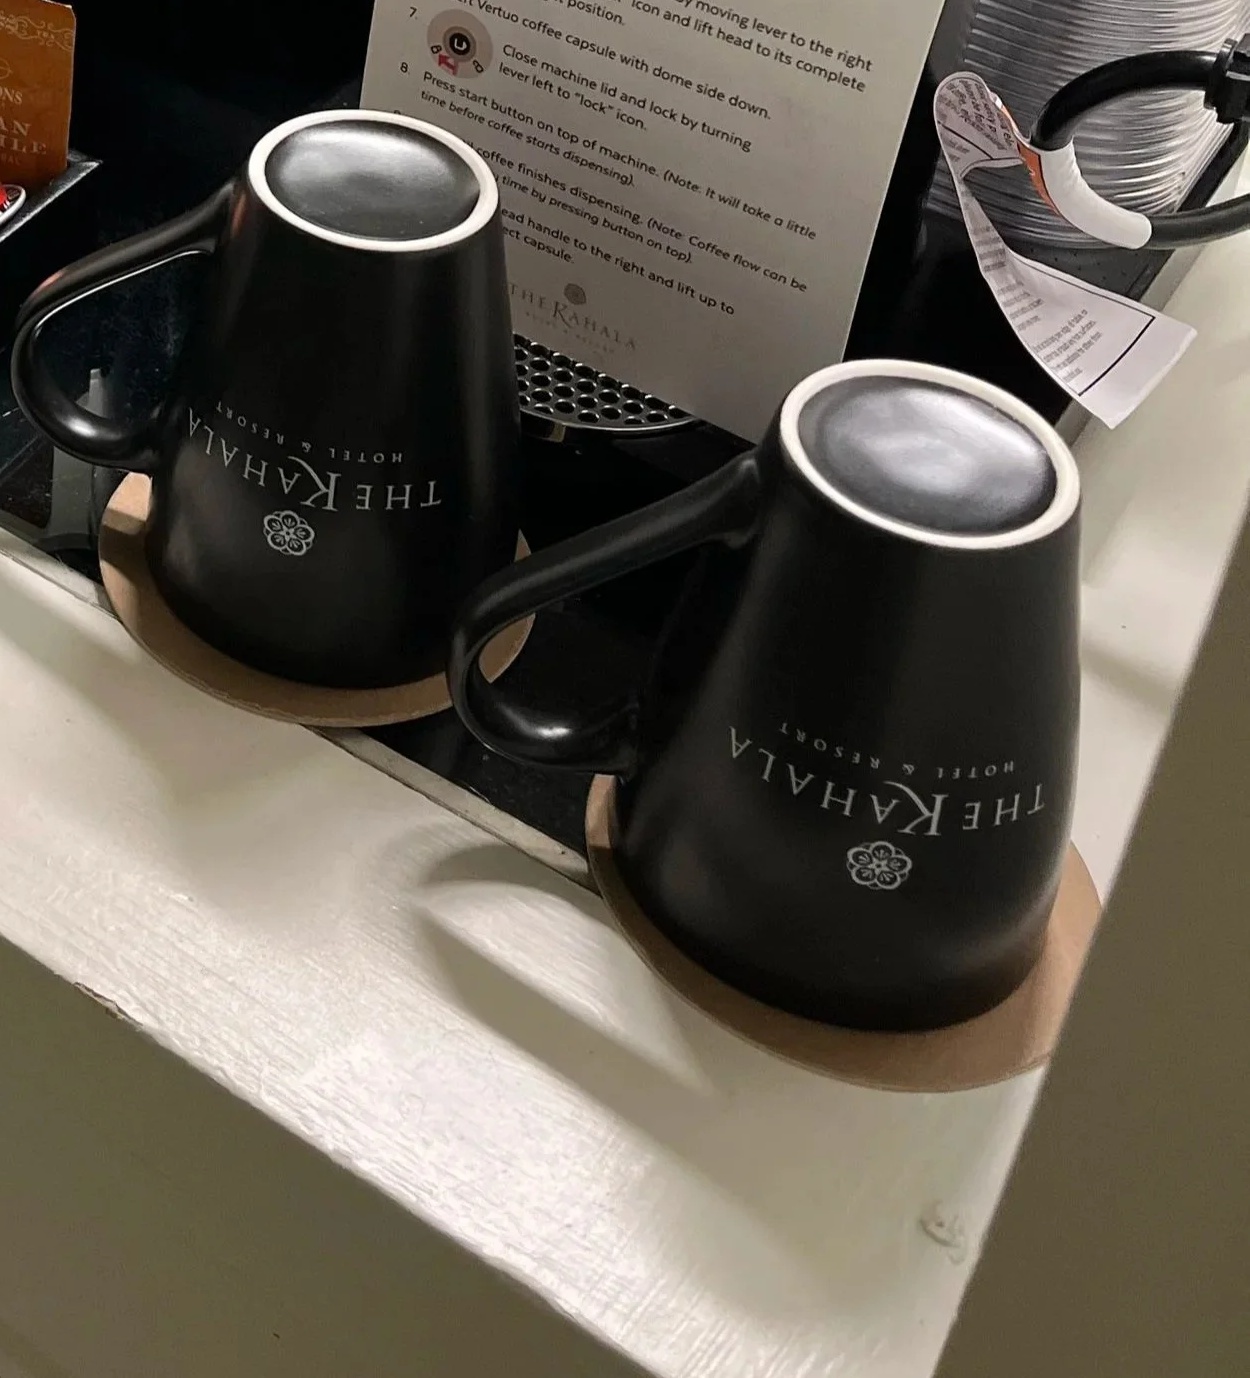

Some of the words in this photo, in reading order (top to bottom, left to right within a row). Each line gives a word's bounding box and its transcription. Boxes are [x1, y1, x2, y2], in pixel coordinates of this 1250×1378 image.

[520, 17, 564, 41] coffee
[564, 33, 618, 62] capsule
[618, 53, 650, 74] with
[651, 65, 694, 91] dome
[694, 82, 727, 103] side
[727, 94, 772, 121] down.
[661, 9, 693, 29] and
[692, 17, 715, 38] lift
[715, 25, 755, 52] head
[755, 41, 772, 58] to
[772, 47, 794, 67] its
[794, 58, 867, 94] complete
[694, 0, 751, 31] moving
[751, 16, 789, 41] lever
[789, 31, 807, 48] to
[808, 38, 835, 59] the
[835, 49, 874, 73] right
[422, 69, 457, 95] Press
[457, 87, 489, 108] start
[489, 97, 535, 127] button
[535, 119, 555, 135] on
[556, 125, 580, 146] top
[581, 138, 599, 152] of
[597, 144, 660, 178] machine.
[497, 60, 531, 84] lever
[531, 73, 555, 95] left
[556, 84, 572, 101] to
[615, 107, 648, 131] icon.
[501, 43, 539, 68] Close
[539, 60, 599, 92] machine
[599, 80, 619, 99] lid
[618, 91, 648, 111] and
[648, 99, 679, 123] lock
[679, 112, 700, 132] by
[700, 120, 753, 154] turning
[516, 161, 568, 193] finishes
[568, 185, 644, 227] dispensing.
[525, 215, 572, 246] handle
[572, 237, 589, 252] to
[589, 244, 613, 263] the
[613, 255, 646, 278] right
[646, 270, 675, 290] and
[676, 280, 696, 300] lift
[697, 292, 719, 309] up
[719, 300, 736, 316] to
[214, 399, 285, 445] RESORT
[330, 446, 404, 463] HOTEL
[188, 407, 341, 512] KAHALA
[355, 480, 442, 511] THE
[728, 726, 950, 837] KAHALA
[778, 722, 881, 770] RESORT
[901, 762, 915, 775] &
[937, 760, 1015, 780] HOTEL
[962, 783, 1046, 830] THE
